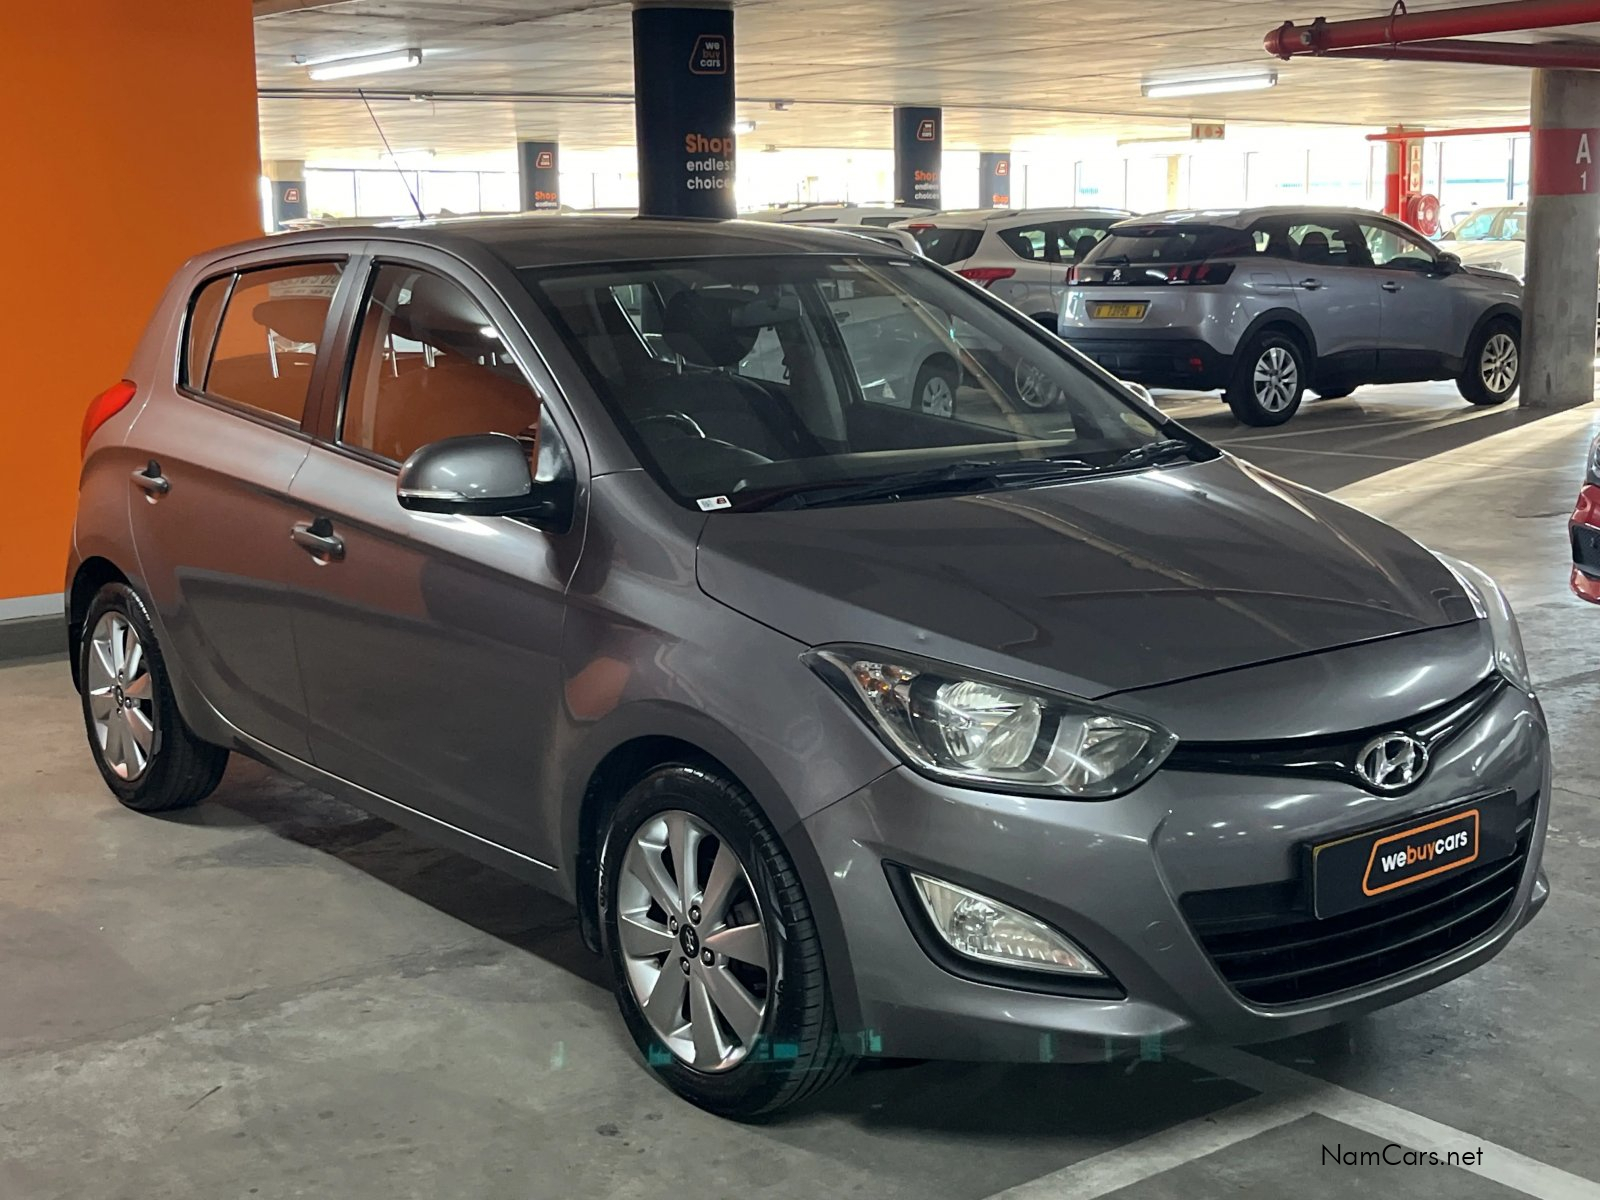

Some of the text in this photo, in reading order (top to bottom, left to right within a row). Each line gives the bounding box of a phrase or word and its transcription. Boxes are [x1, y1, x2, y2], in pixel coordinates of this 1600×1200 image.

[704, 42, 721, 50] we
[702, 48, 721, 59] buy
[700, 59, 721, 67] cars
[685, 133, 734, 157] Shop
[1575, 133, 1592, 165] A
[914, 170, 938, 182] Shop
[1580, 170, 1587, 191] 1
[534, 191, 557, 202] Shop
[1381, 830, 1468, 873] webuycars
